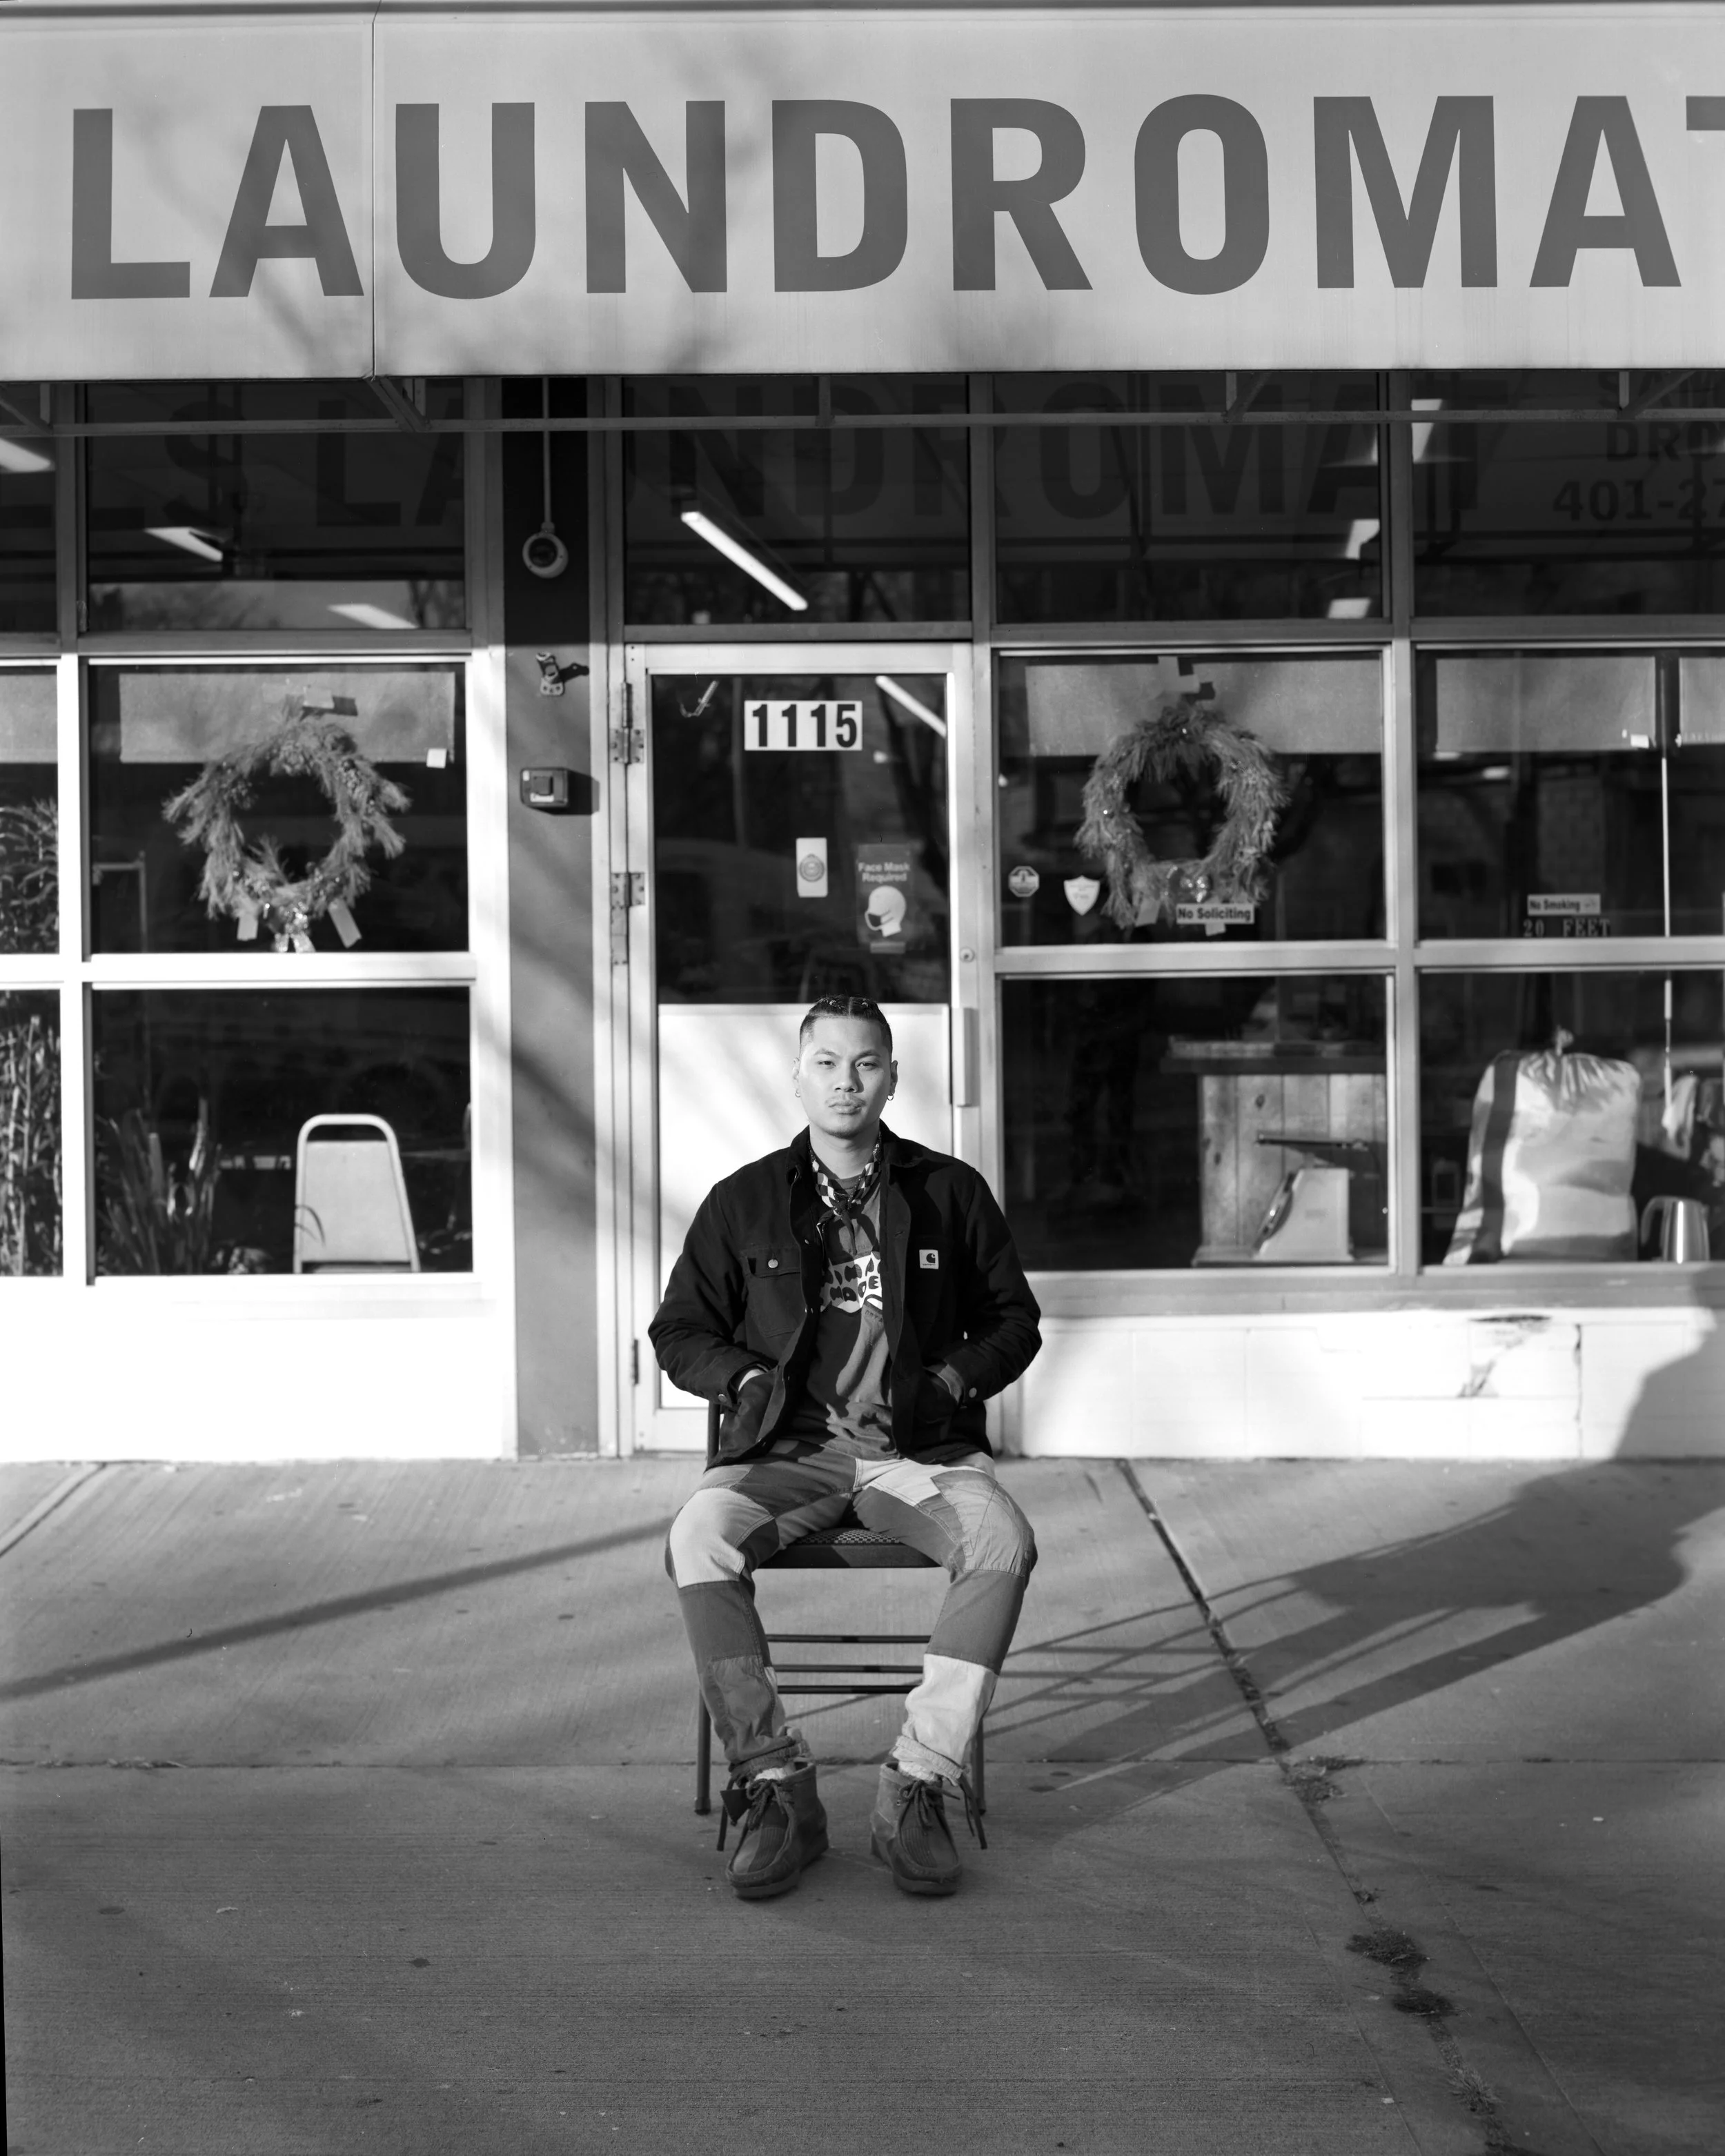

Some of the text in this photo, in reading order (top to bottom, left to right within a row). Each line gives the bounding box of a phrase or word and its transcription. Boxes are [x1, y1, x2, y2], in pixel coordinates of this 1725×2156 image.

[1606, 421, 1725, 462] DRO
[752, 704, 857, 749] 1115
[858, 861, 910, 872] Face Mask
[862, 872, 907, 883] Required
[1529, 898, 1580, 912] No Smoking
[1178, 907, 1251, 922] No Soliciting
[1523, 918, 1610, 938] 20 FEET
